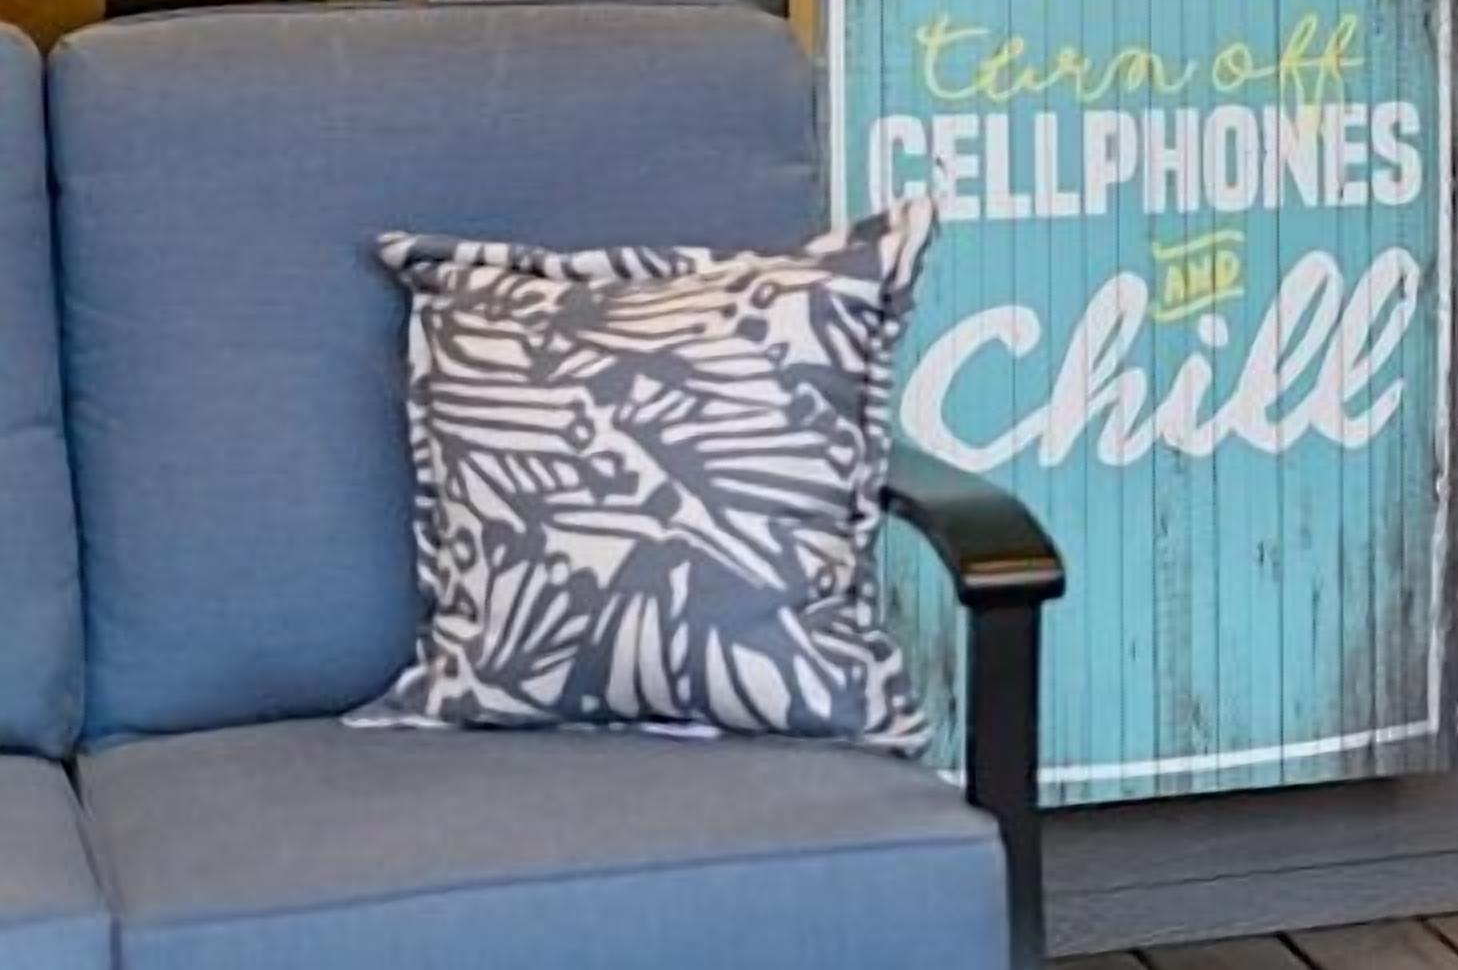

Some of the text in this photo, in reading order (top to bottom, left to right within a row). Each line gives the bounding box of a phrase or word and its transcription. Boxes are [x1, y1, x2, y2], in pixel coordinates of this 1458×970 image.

[916, 13, 1364, 128] turn off
[869, 101, 1422, 220] CELLPHONES
[1163, 256, 1239, 300] AND
[899, 247, 1420, 473] Chill
